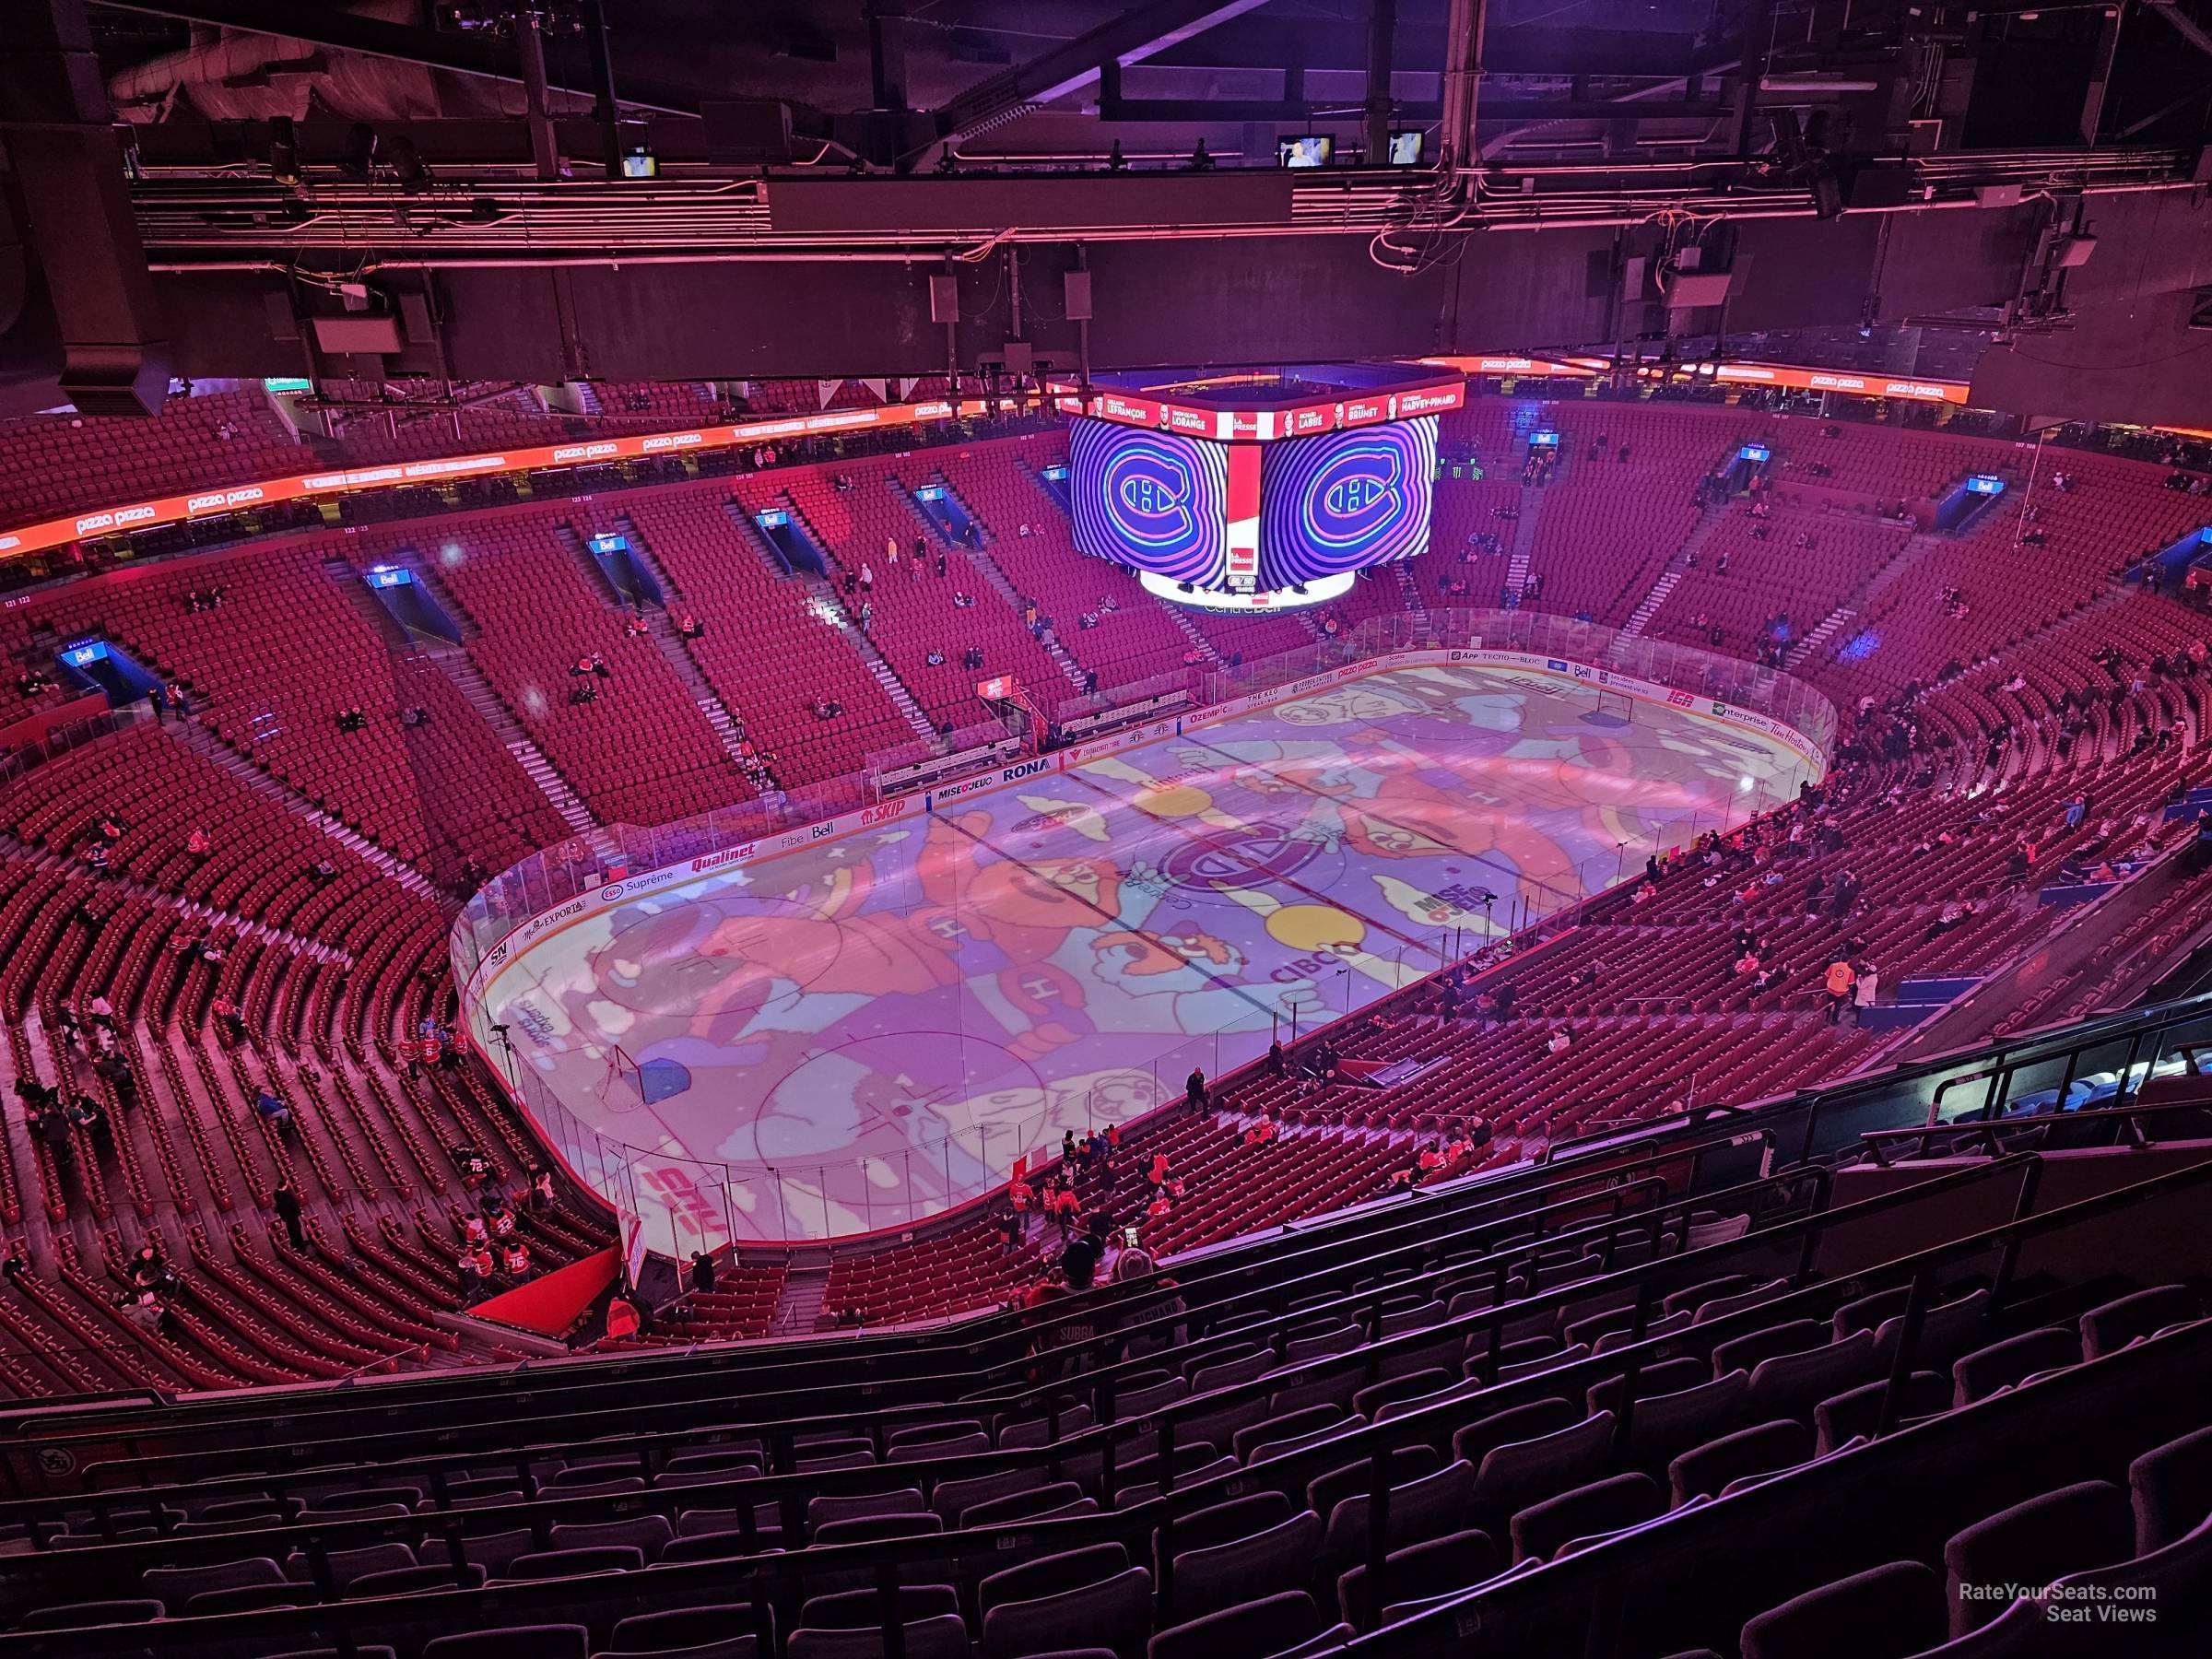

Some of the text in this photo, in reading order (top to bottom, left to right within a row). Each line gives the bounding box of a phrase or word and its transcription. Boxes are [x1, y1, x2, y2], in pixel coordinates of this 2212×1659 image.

[1811, 375, 1864, 389] pizza pizza
[1887, 382, 1944, 398] pizza pizza
[1402, 394, 1456, 412] HARVEY-PINARD
[1107, 404, 1147, 420] LEFRANÇOIS
[1348, 406, 1378, 421] BRUNET
[1172, 416, 1206, 430] LORANGE
[1234, 423, 1257, 431] PRESSE
[642, 434, 702, 451] pizza pizza
[554, 443, 618, 462] pizza pizza
[1978, 481, 1993, 490] Bell
[187, 488, 264, 512] pizza pizza
[76, 506, 156, 535] pizza pizza
[600, 540, 615, 550] Bell
[381, 573, 397, 584] Bell
[5, 595, 30, 607] 121 122
[76, 649, 93, 661] Bell
[1338, 660, 1377, 679] pizza pizza
[1575, 665, 1591, 679] Bell
[1247, 688, 1278, 702] THE KEG
[1770, 722, 1784, 738] Tim
[1784, 729, 1810, 756] Hortons
[1003, 759, 1050, 782] RONA
[874, 800, 906, 822] SKIP
[812, 823, 834, 839] Bell
[782, 833, 804, 848] Fibe
[691, 843, 755, 873] Qualinet
[627, 872, 673, 891] Suprême
[491, 942, 507, 965] SN
[1270, 951, 1341, 983] CIBC
[470, 1162, 483, 1171] 72
[498, 1218, 513, 1234] 22
